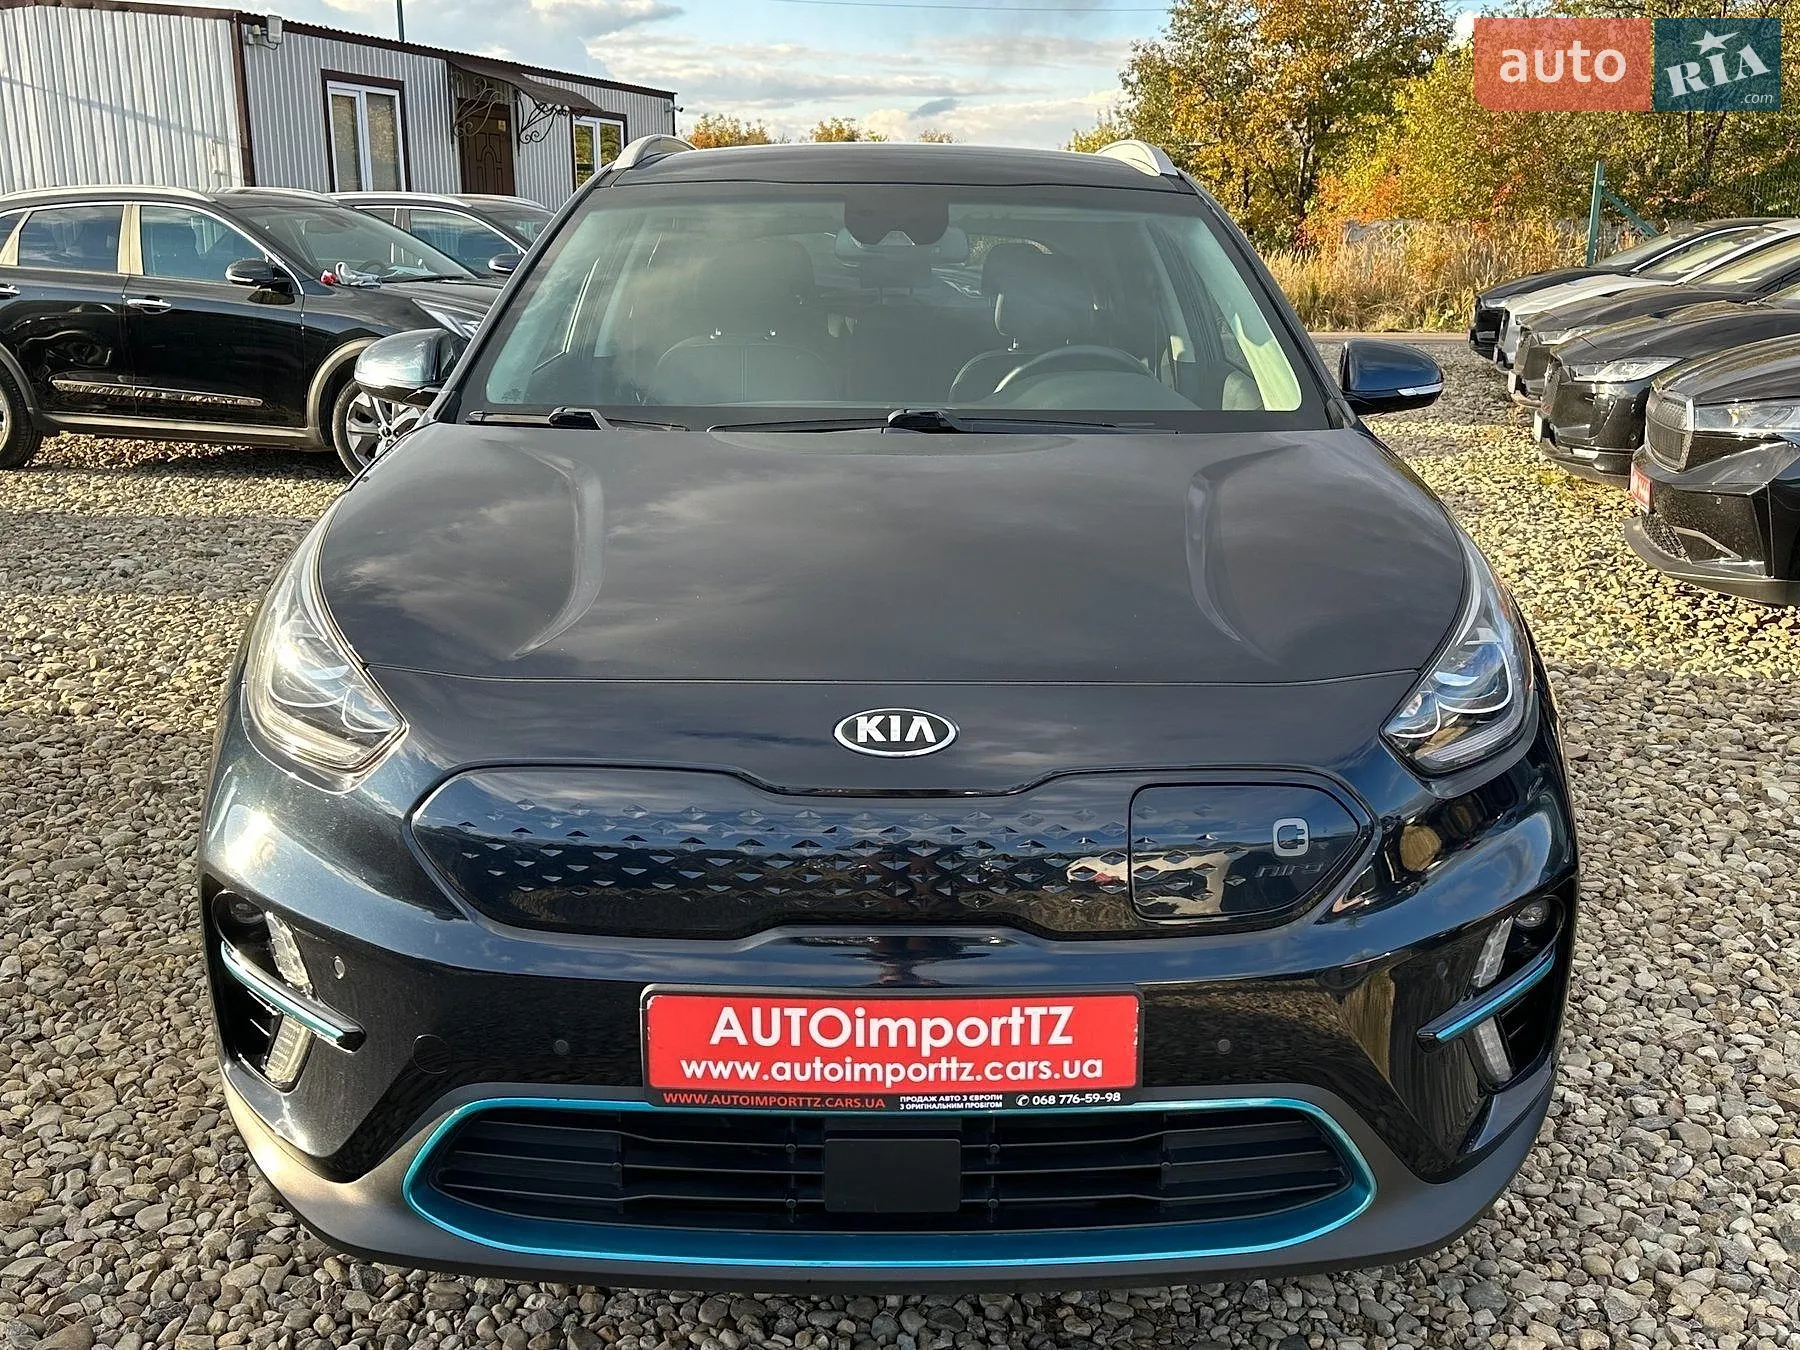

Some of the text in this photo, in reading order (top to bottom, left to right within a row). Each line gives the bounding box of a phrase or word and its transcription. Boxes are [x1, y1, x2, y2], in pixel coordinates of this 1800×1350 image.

[856, 715, 937, 743] KIA
[709, 1005, 1075, 1057] AUTOimportTZ
[680, 1056, 1103, 1088] www.autoimporttz.cars.ua
[663, 1092, 886, 1109] WWW.AUTOIMPORTTZ.CARS.UA
[900, 1095, 937, 1103] ПРОДАЖ
[965, 1101, 1003, 1109] ПРОБІГОМ
[1032, 1092, 1121, 1105] 068 776-59-98
